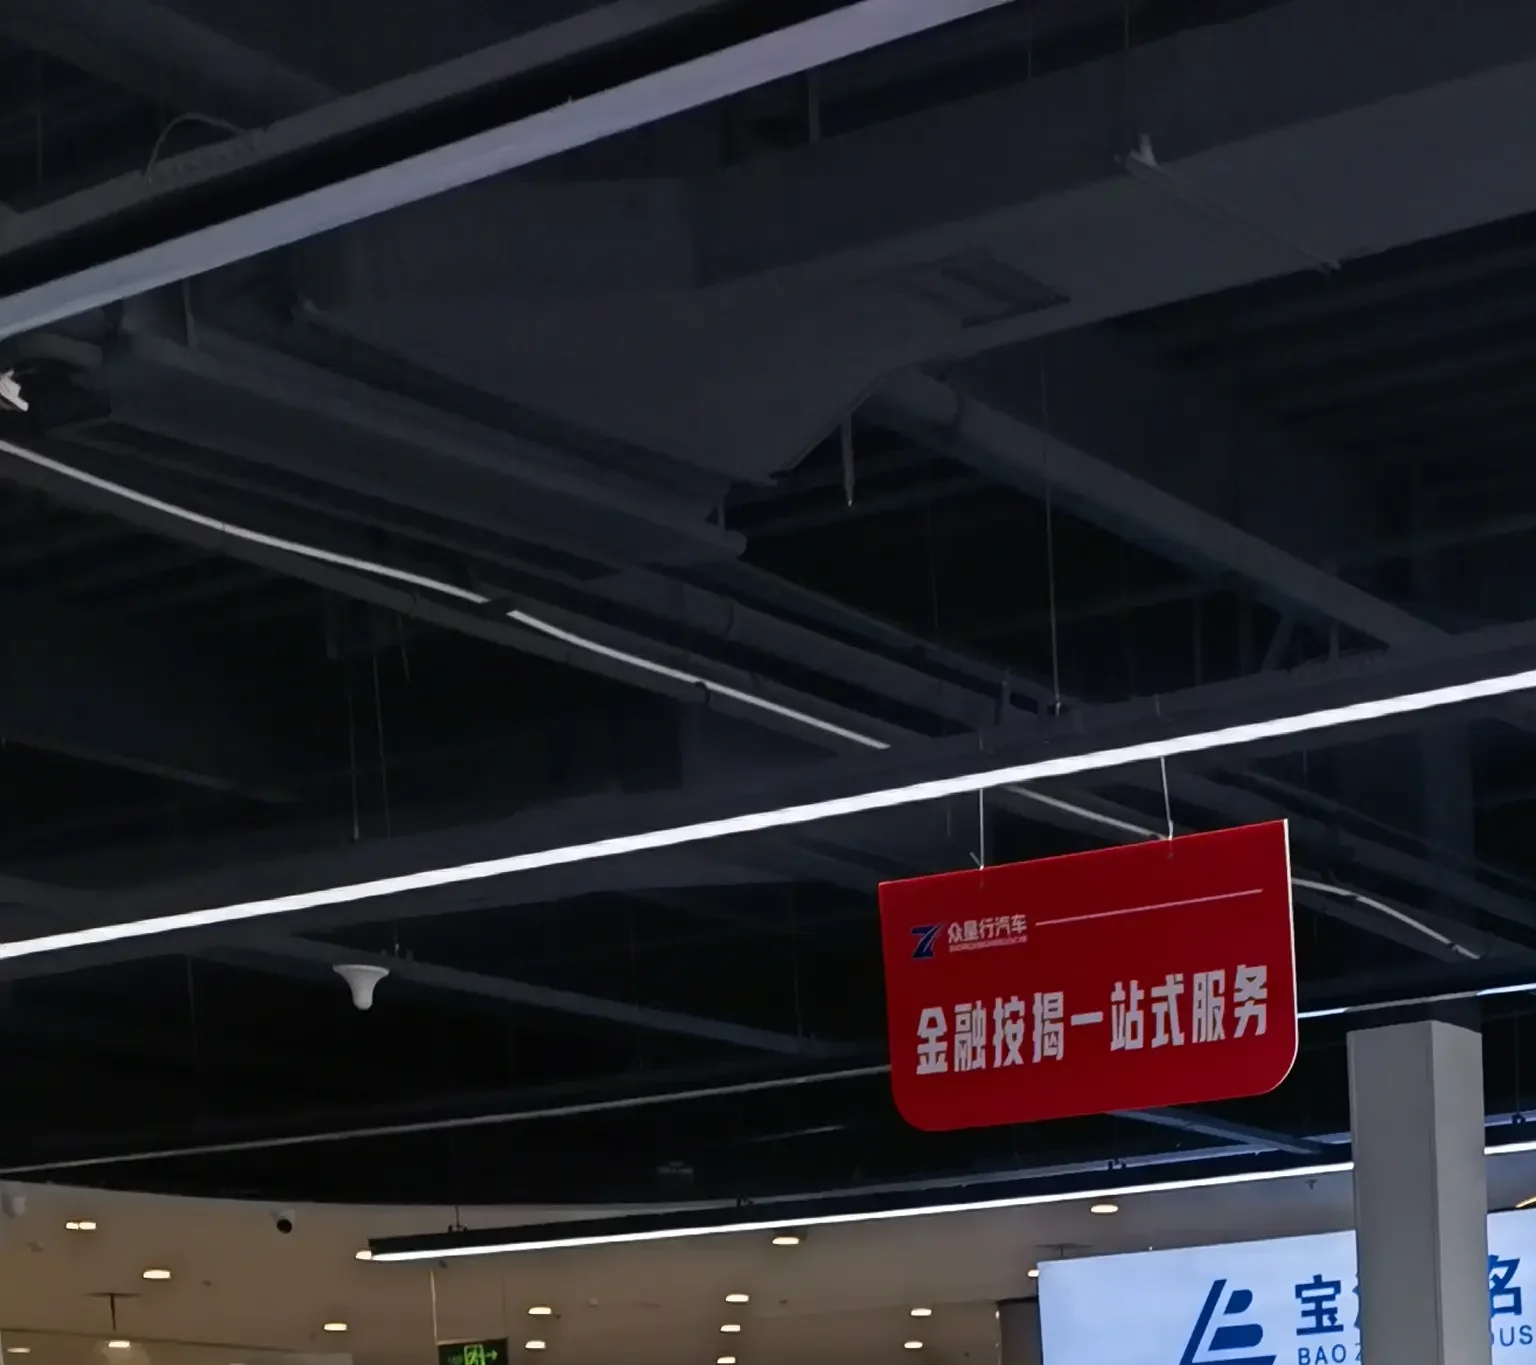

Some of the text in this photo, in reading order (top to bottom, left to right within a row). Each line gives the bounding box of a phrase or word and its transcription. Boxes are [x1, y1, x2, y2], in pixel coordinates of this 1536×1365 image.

[916, 964, 1267, 1075] 金融按揭一站式服务
